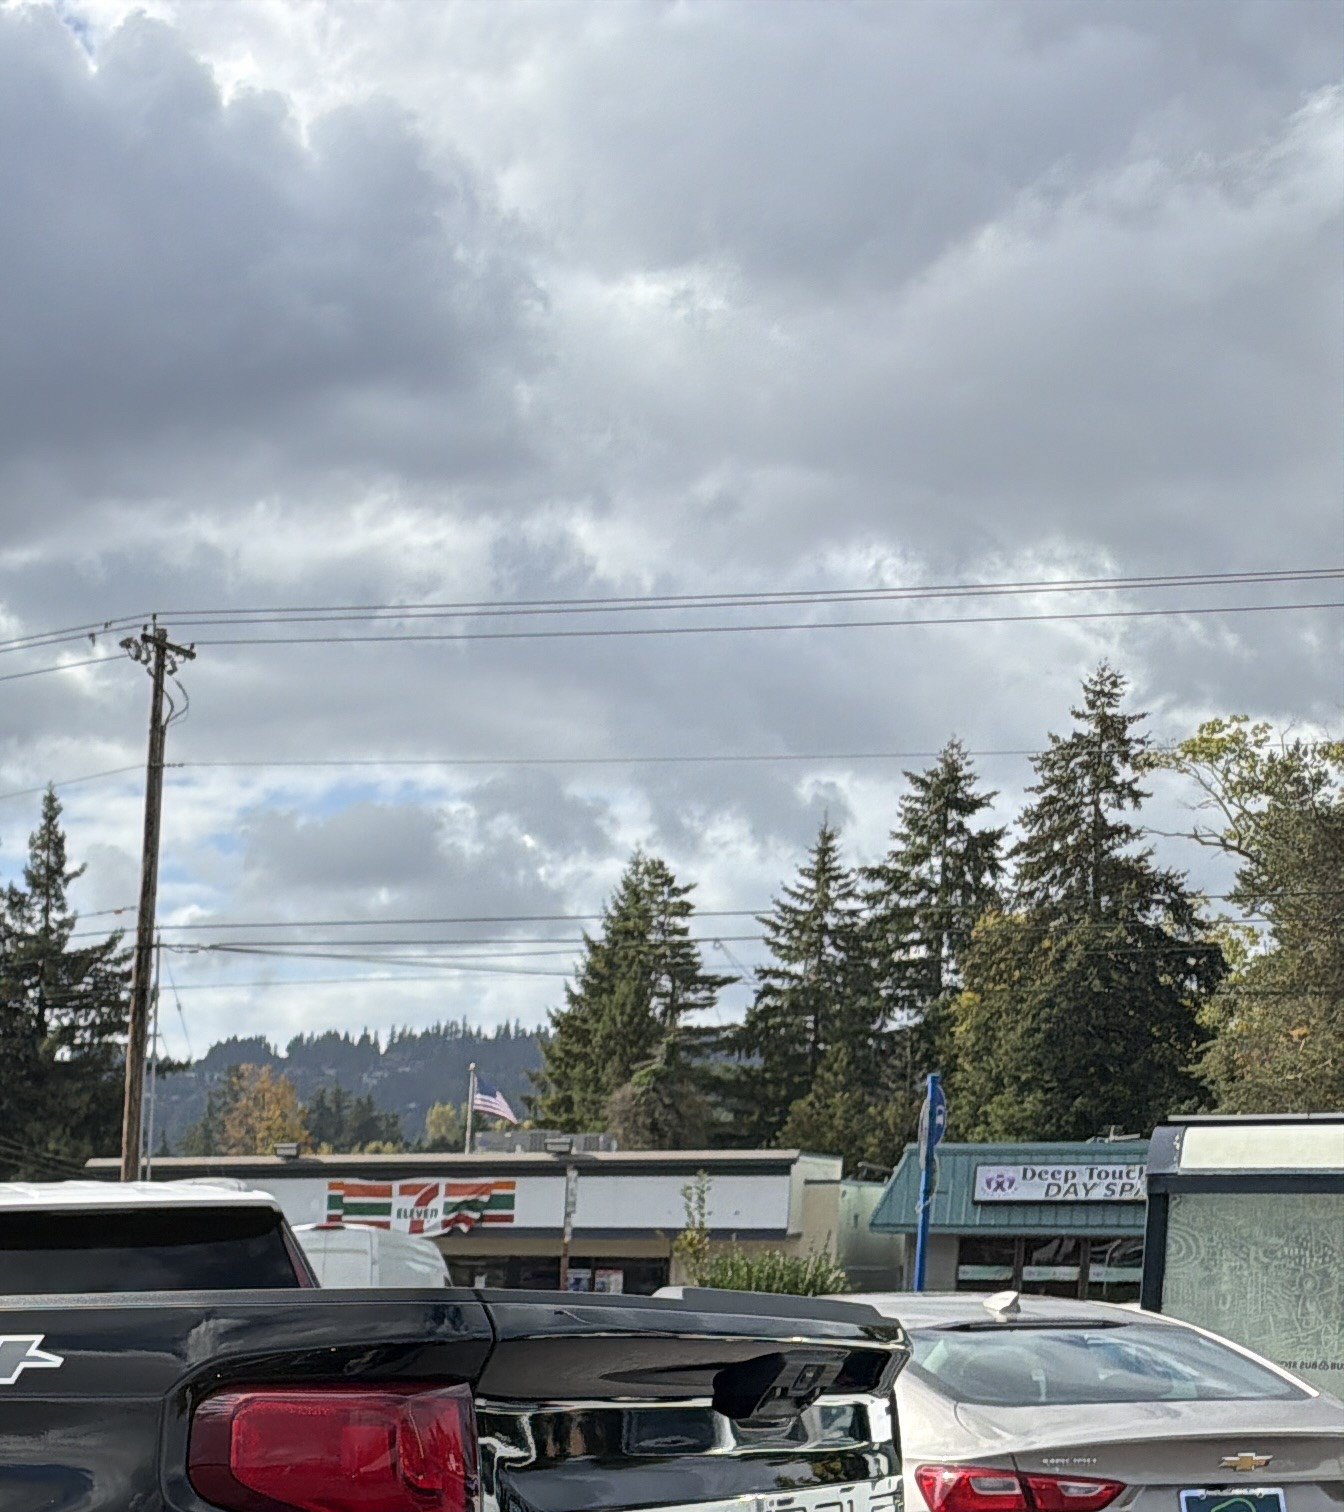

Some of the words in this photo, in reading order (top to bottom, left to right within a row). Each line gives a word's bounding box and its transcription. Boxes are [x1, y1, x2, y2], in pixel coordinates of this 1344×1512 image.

[1022, 1167, 1077, 1184] Deep
[1044, 1182, 1097, 1198] DAY
[1103, 1182, 1141, 1198] SP
